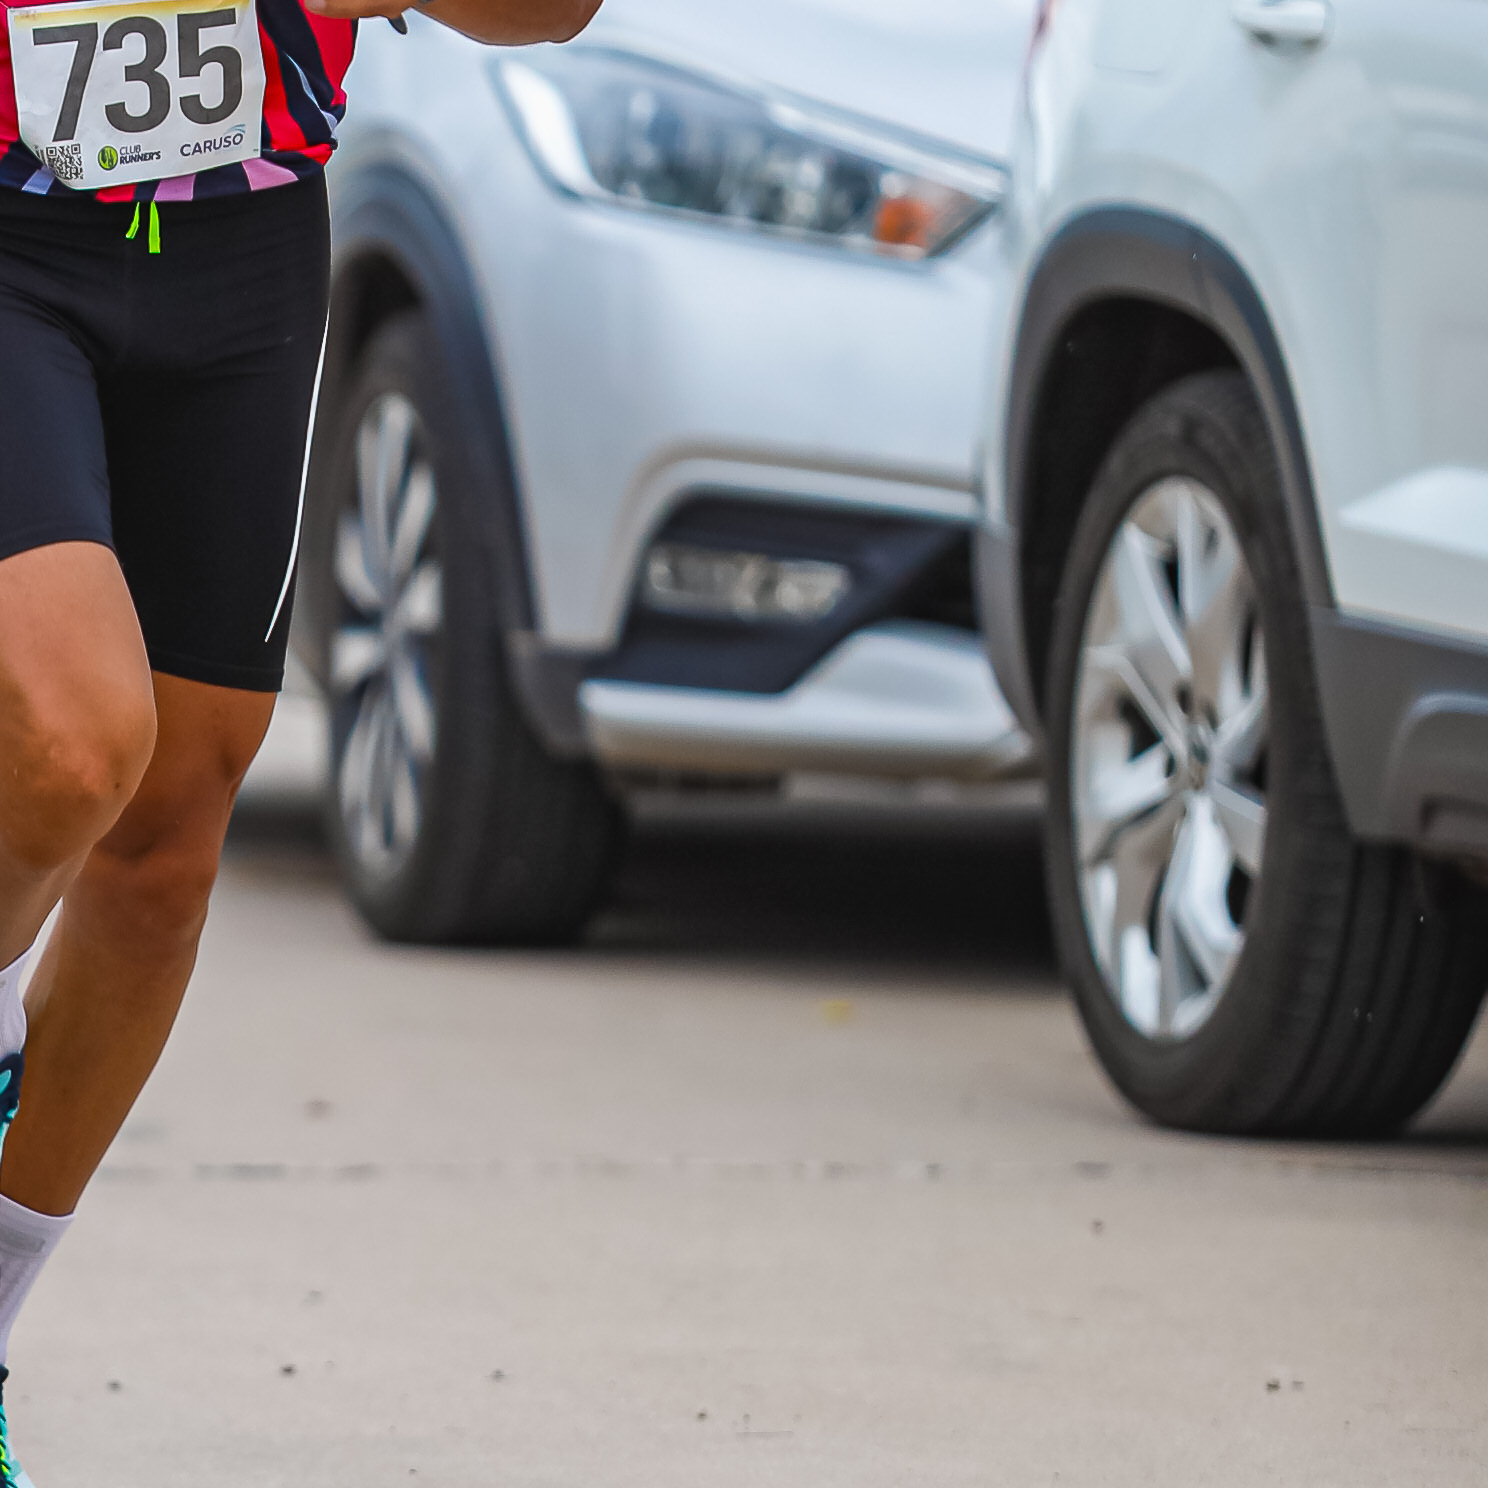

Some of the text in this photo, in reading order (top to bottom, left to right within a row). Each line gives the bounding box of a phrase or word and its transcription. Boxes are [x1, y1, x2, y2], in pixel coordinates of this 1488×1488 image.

[32, 8, 242, 142] 735
[119, 144, 142, 155] CLUB
[180, 133, 244, 157] CARUSO
[119, 150, 161, 165] RUNNER'S
